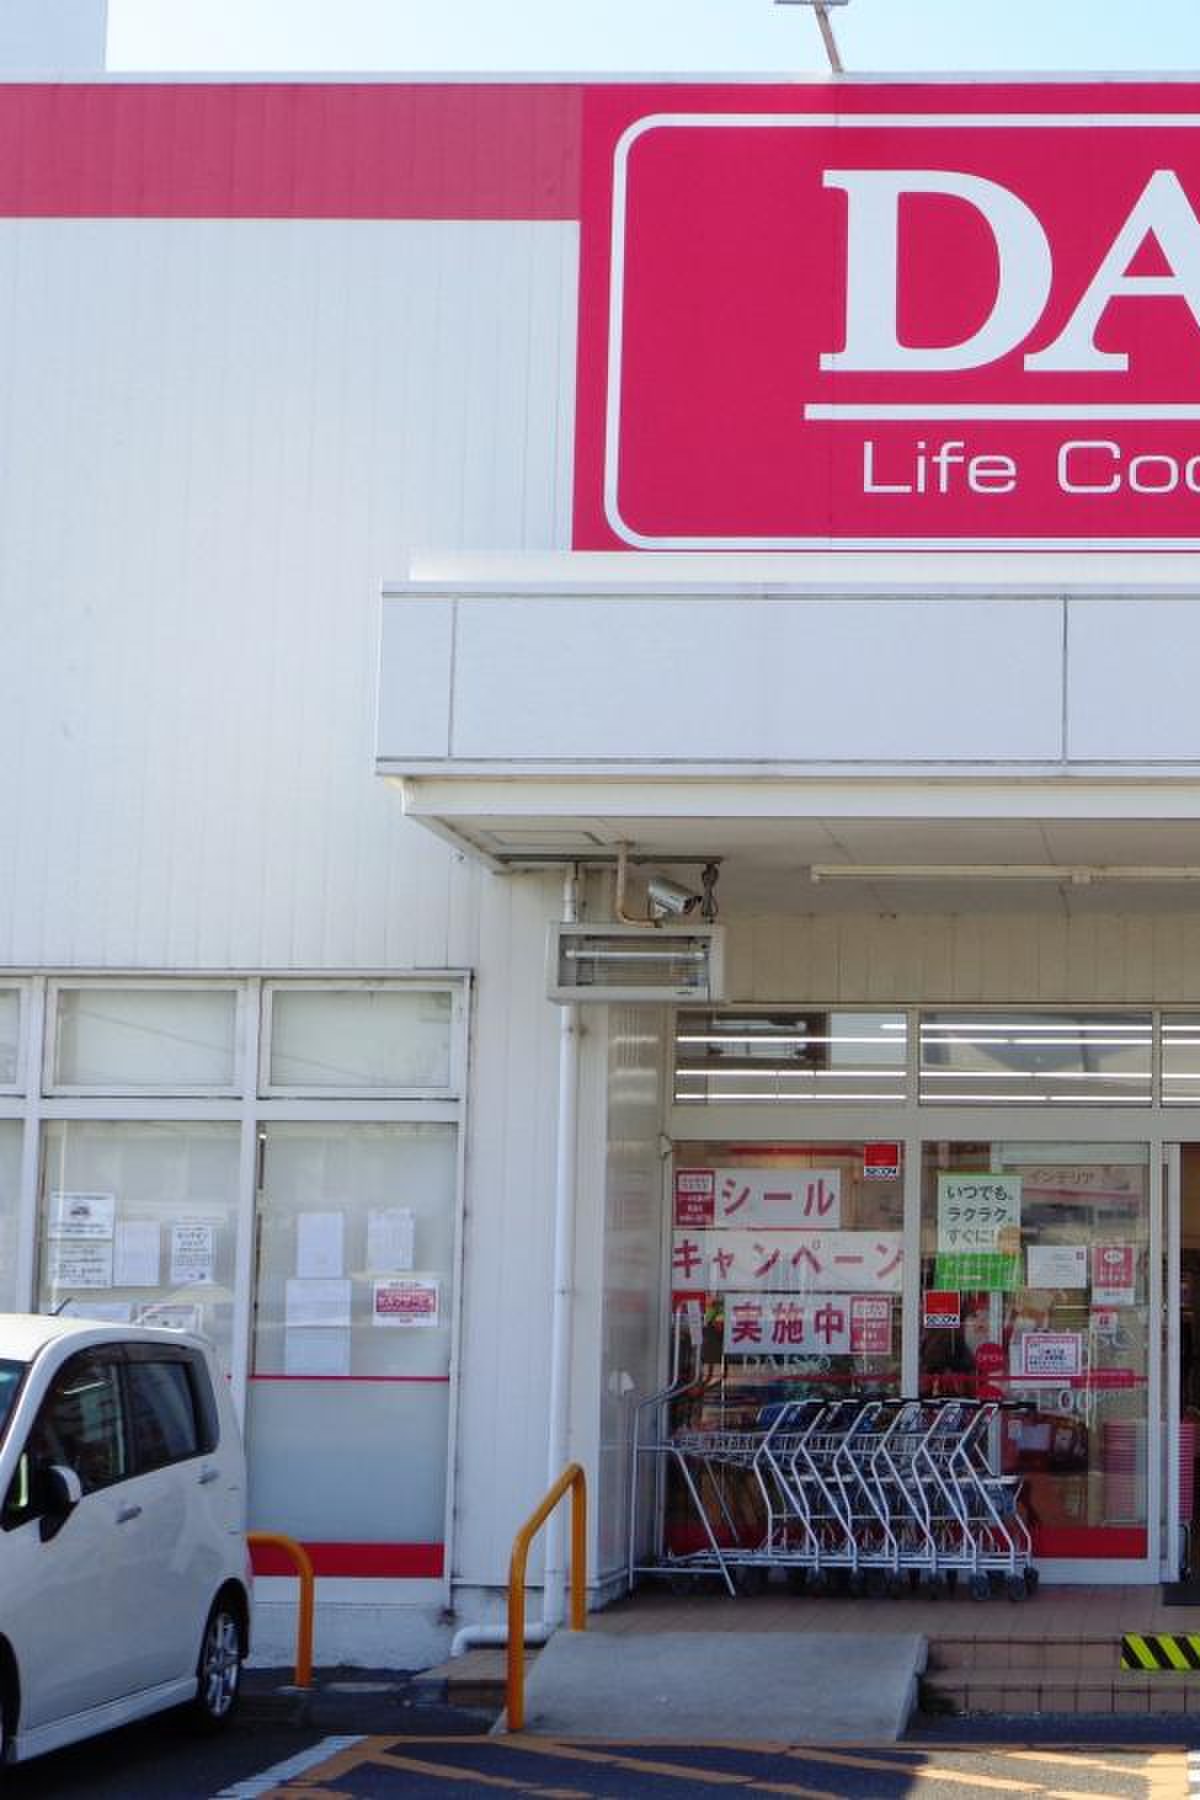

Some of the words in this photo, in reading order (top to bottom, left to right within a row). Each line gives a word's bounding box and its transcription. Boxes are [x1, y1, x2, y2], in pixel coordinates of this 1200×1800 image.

[863, 441, 1017, 493] Life
[722, 1179, 835, 1216] シール
[673, 1239, 903, 1278] キャンペーン
[732, 1303, 846, 1345] 実施中
